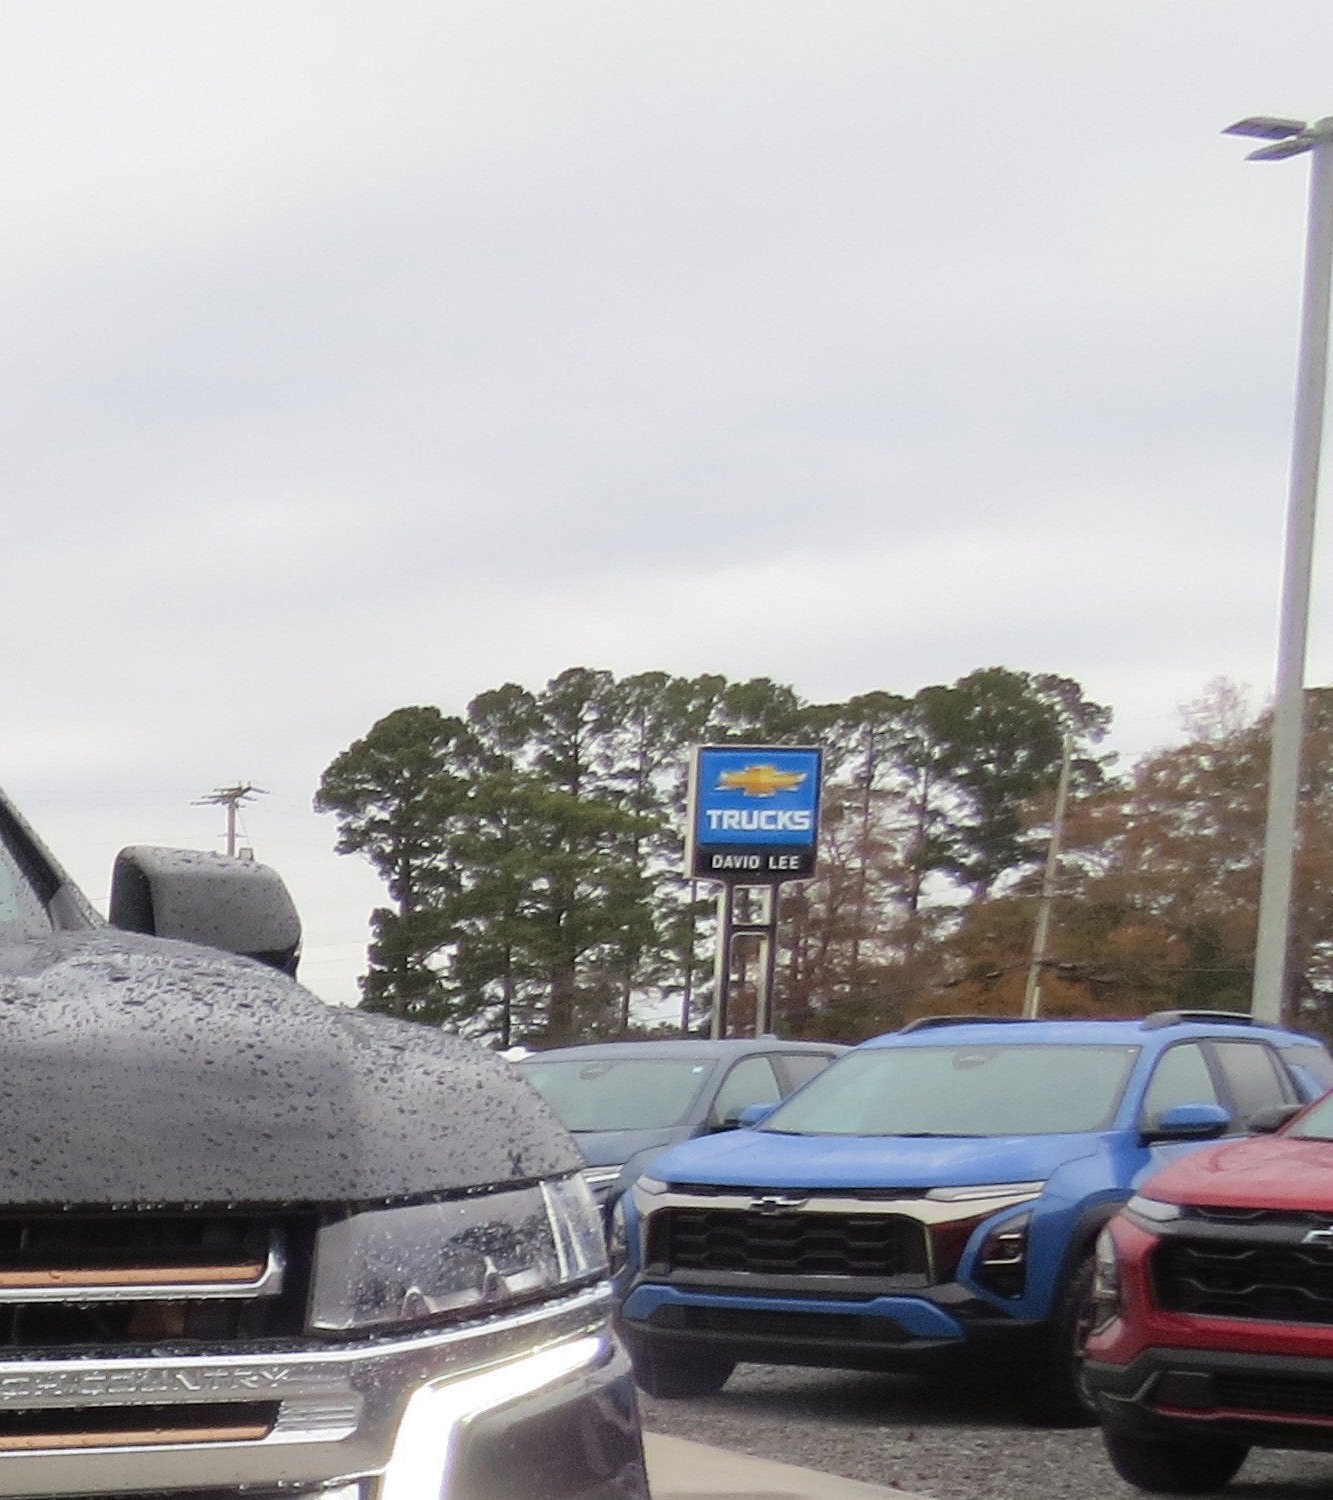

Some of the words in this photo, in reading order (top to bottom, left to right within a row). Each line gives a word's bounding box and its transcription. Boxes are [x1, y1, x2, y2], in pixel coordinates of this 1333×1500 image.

[706, 809, 812, 831] TRUCKS
[711, 854, 760, 870] DAVID
[768, 855, 800, 870] LEE
[81, 1367, 291, 1395] COUNTRY
